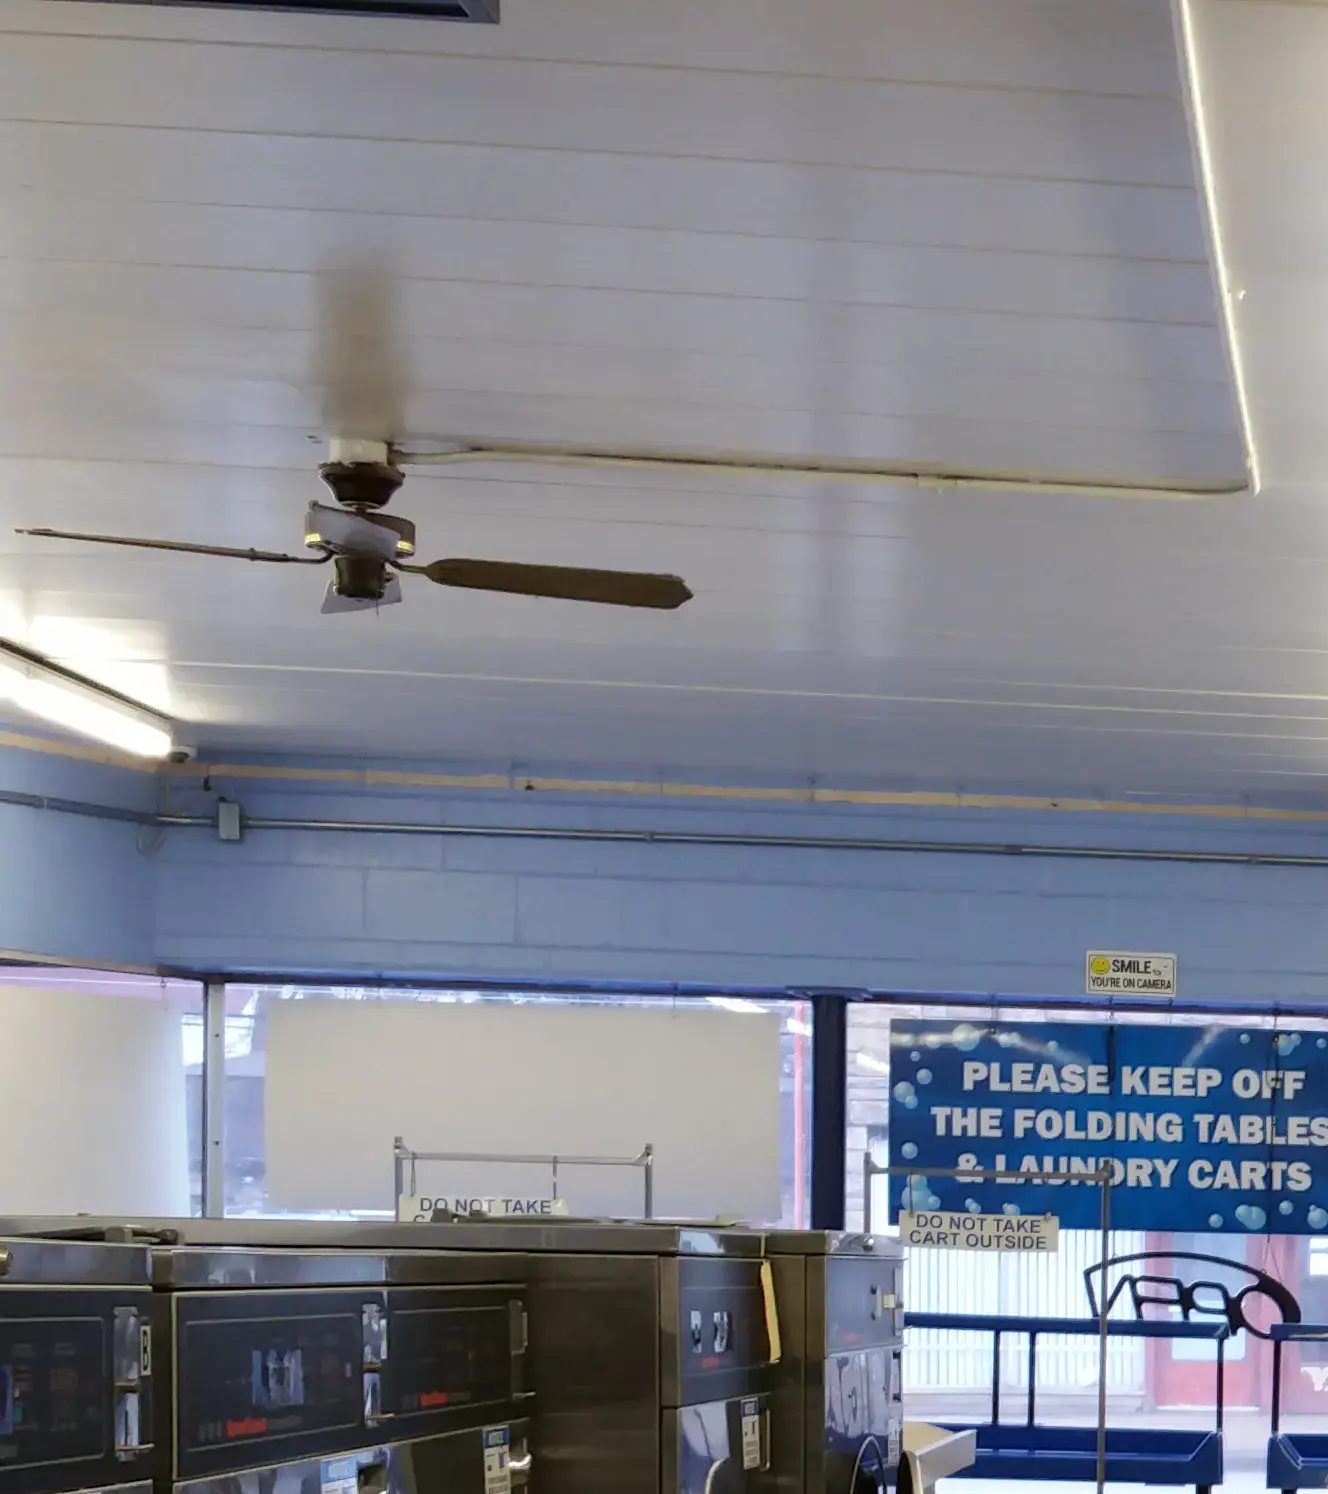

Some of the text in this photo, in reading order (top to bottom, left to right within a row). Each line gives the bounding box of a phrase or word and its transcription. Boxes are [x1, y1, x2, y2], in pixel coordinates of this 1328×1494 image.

[1112, 959, 1152, 974] SMILE
[1091, 976, 1171, 990] YOU'RE ON CAMERA
[963, 1061, 1306, 1099] PLEASE KEEP OFF
[931, 1107, 1003, 1137] THE
[1013, 1109, 1183, 1141] FOLDING
[955, 1153, 1312, 1191] & LAUNDRY CARTS
[420, 1198, 552, 1213] DO NOT TAKE
[916, 1214, 1041, 1234] DO NOT TAKE
[909, 1230, 1047, 1249] CART OUTSIDE
